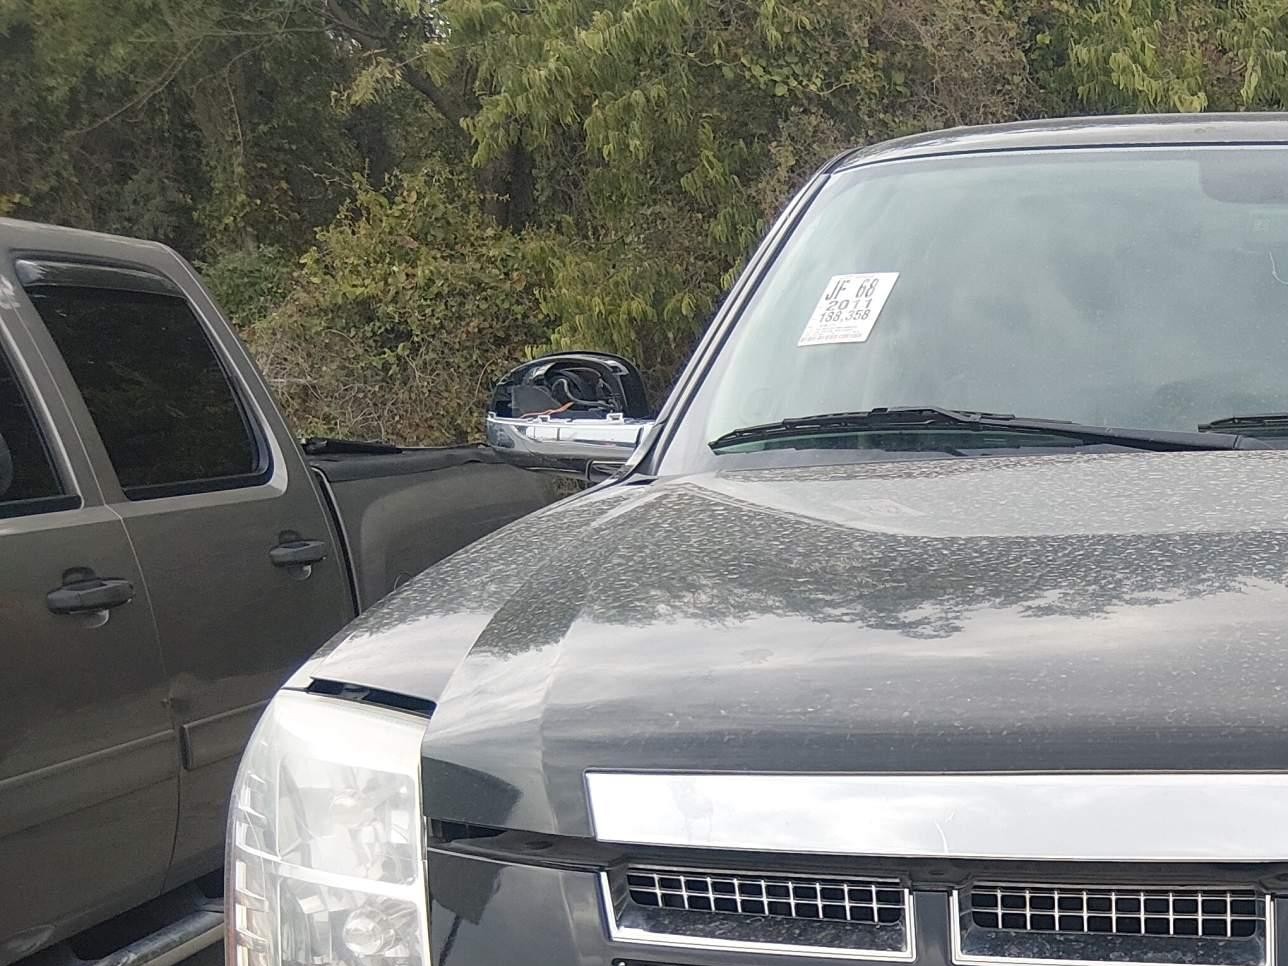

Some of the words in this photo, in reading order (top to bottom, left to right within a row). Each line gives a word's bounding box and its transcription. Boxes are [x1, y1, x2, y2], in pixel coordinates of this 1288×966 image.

[825, 279, 850, 301] JF
[855, 278, 880, 299] 68
[825, 298, 873, 311] 2011
